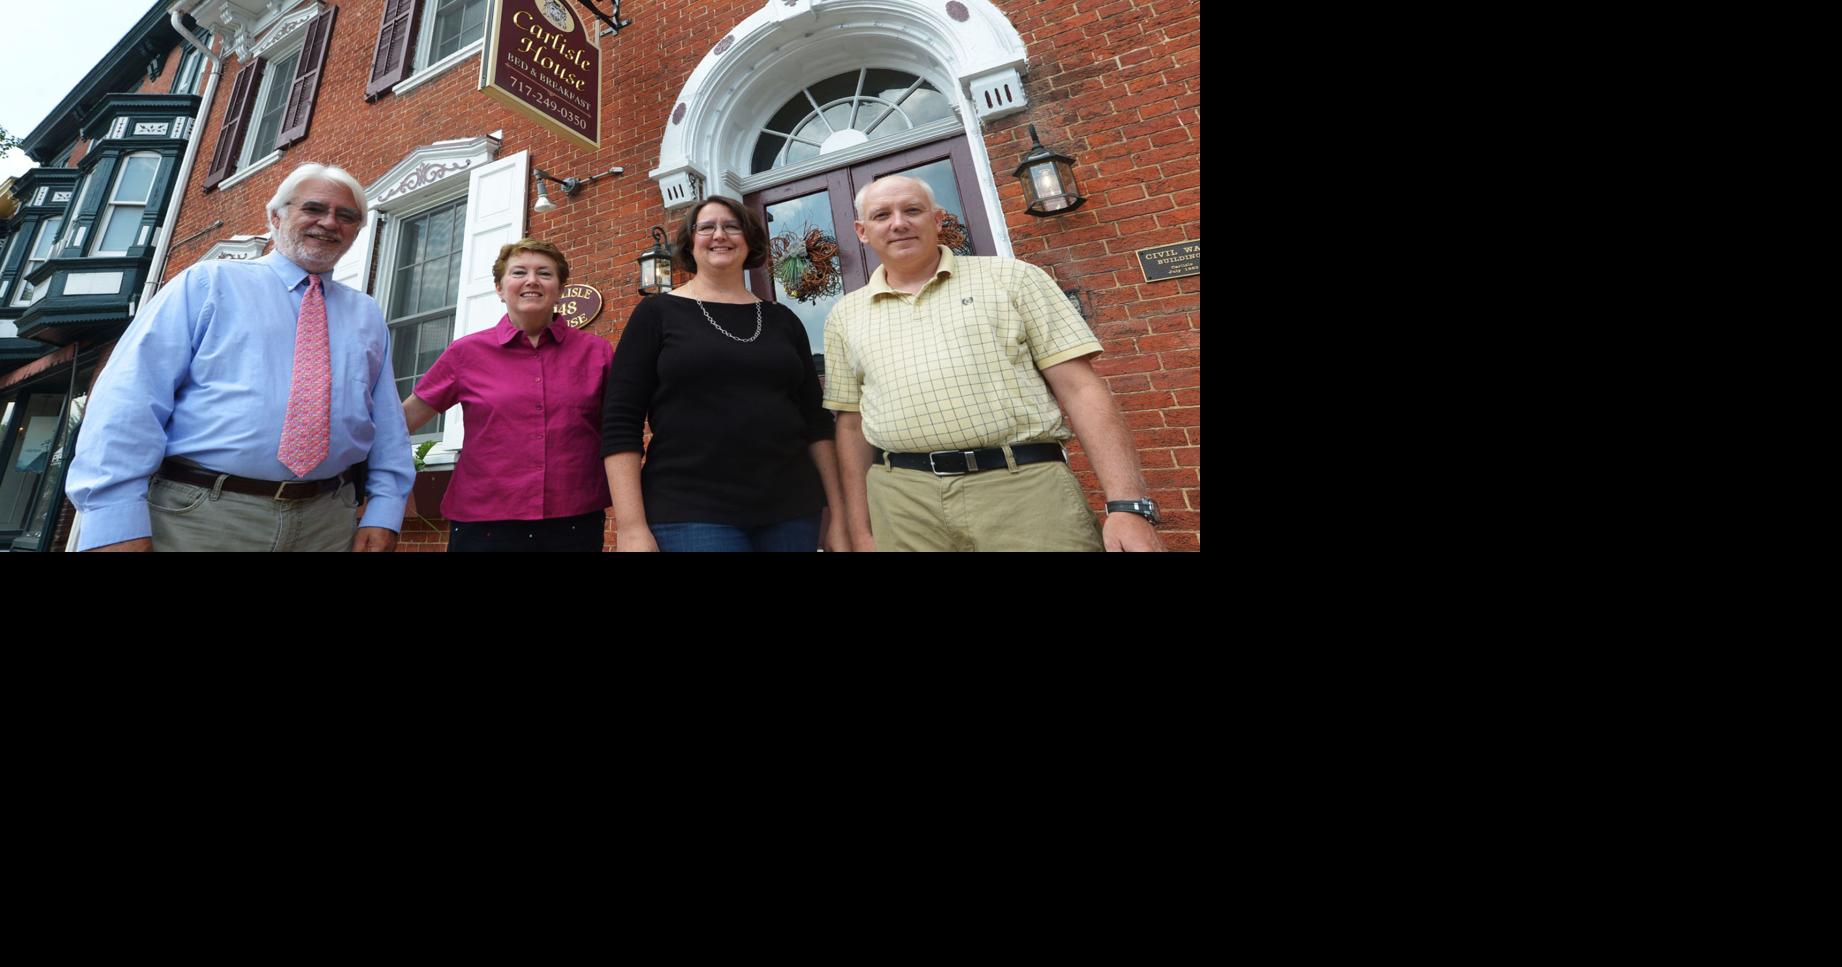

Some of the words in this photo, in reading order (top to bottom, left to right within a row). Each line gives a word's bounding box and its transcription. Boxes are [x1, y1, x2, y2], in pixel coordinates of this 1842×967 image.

[513, 10, 591, 71] Carlisle
[517, 37, 585, 91] House
[507, 52, 529, 71] BED
[530, 67, 538, 77] &
[540, 73, 592, 111] BREAKFAST
[510, 75, 588, 130] 717-249-0350
[1145, 249, 1178, 260] CIVIL
